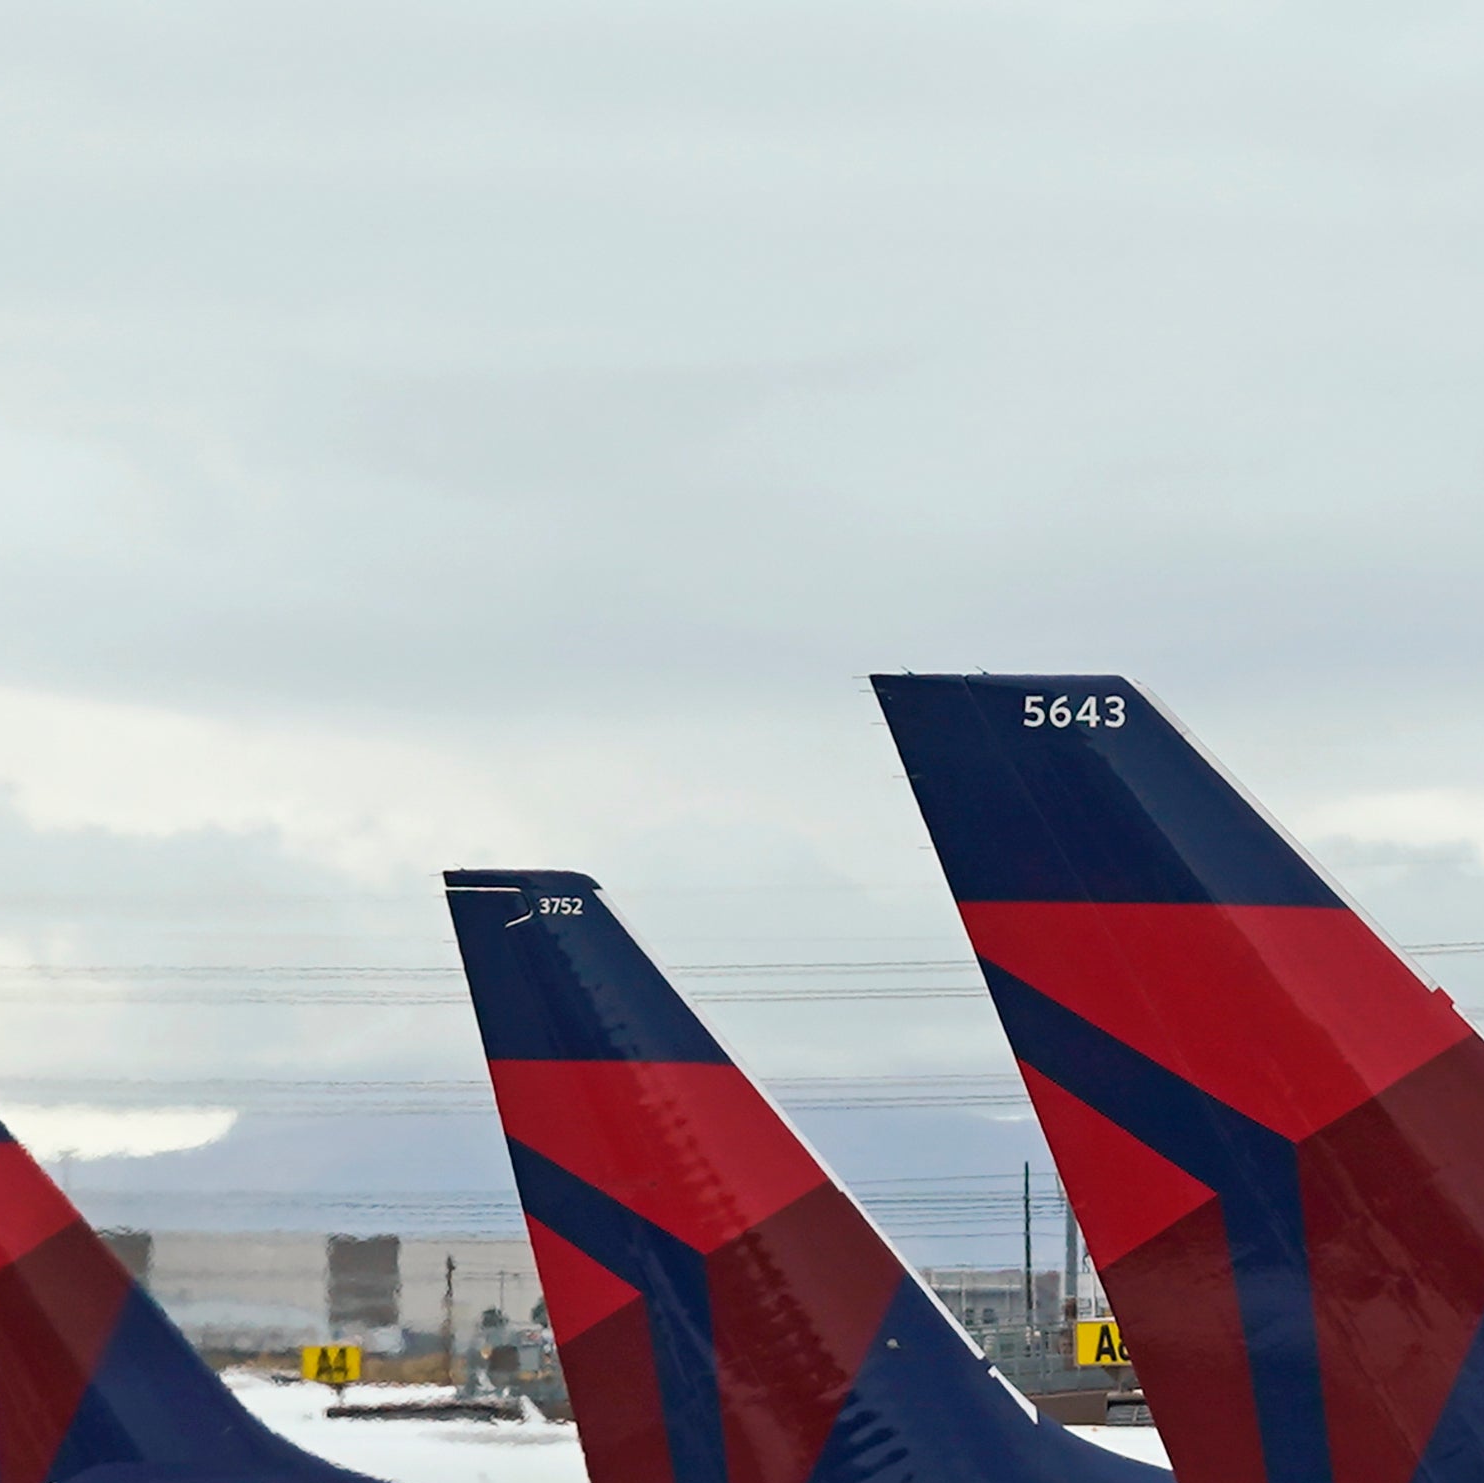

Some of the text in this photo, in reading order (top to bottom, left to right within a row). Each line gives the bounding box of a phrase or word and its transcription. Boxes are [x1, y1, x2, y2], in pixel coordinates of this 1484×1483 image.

[1023, 695, 1126, 728] 5643
[539, 897, 584, 915] 3752
[316, 1346, 349, 1379] A4
